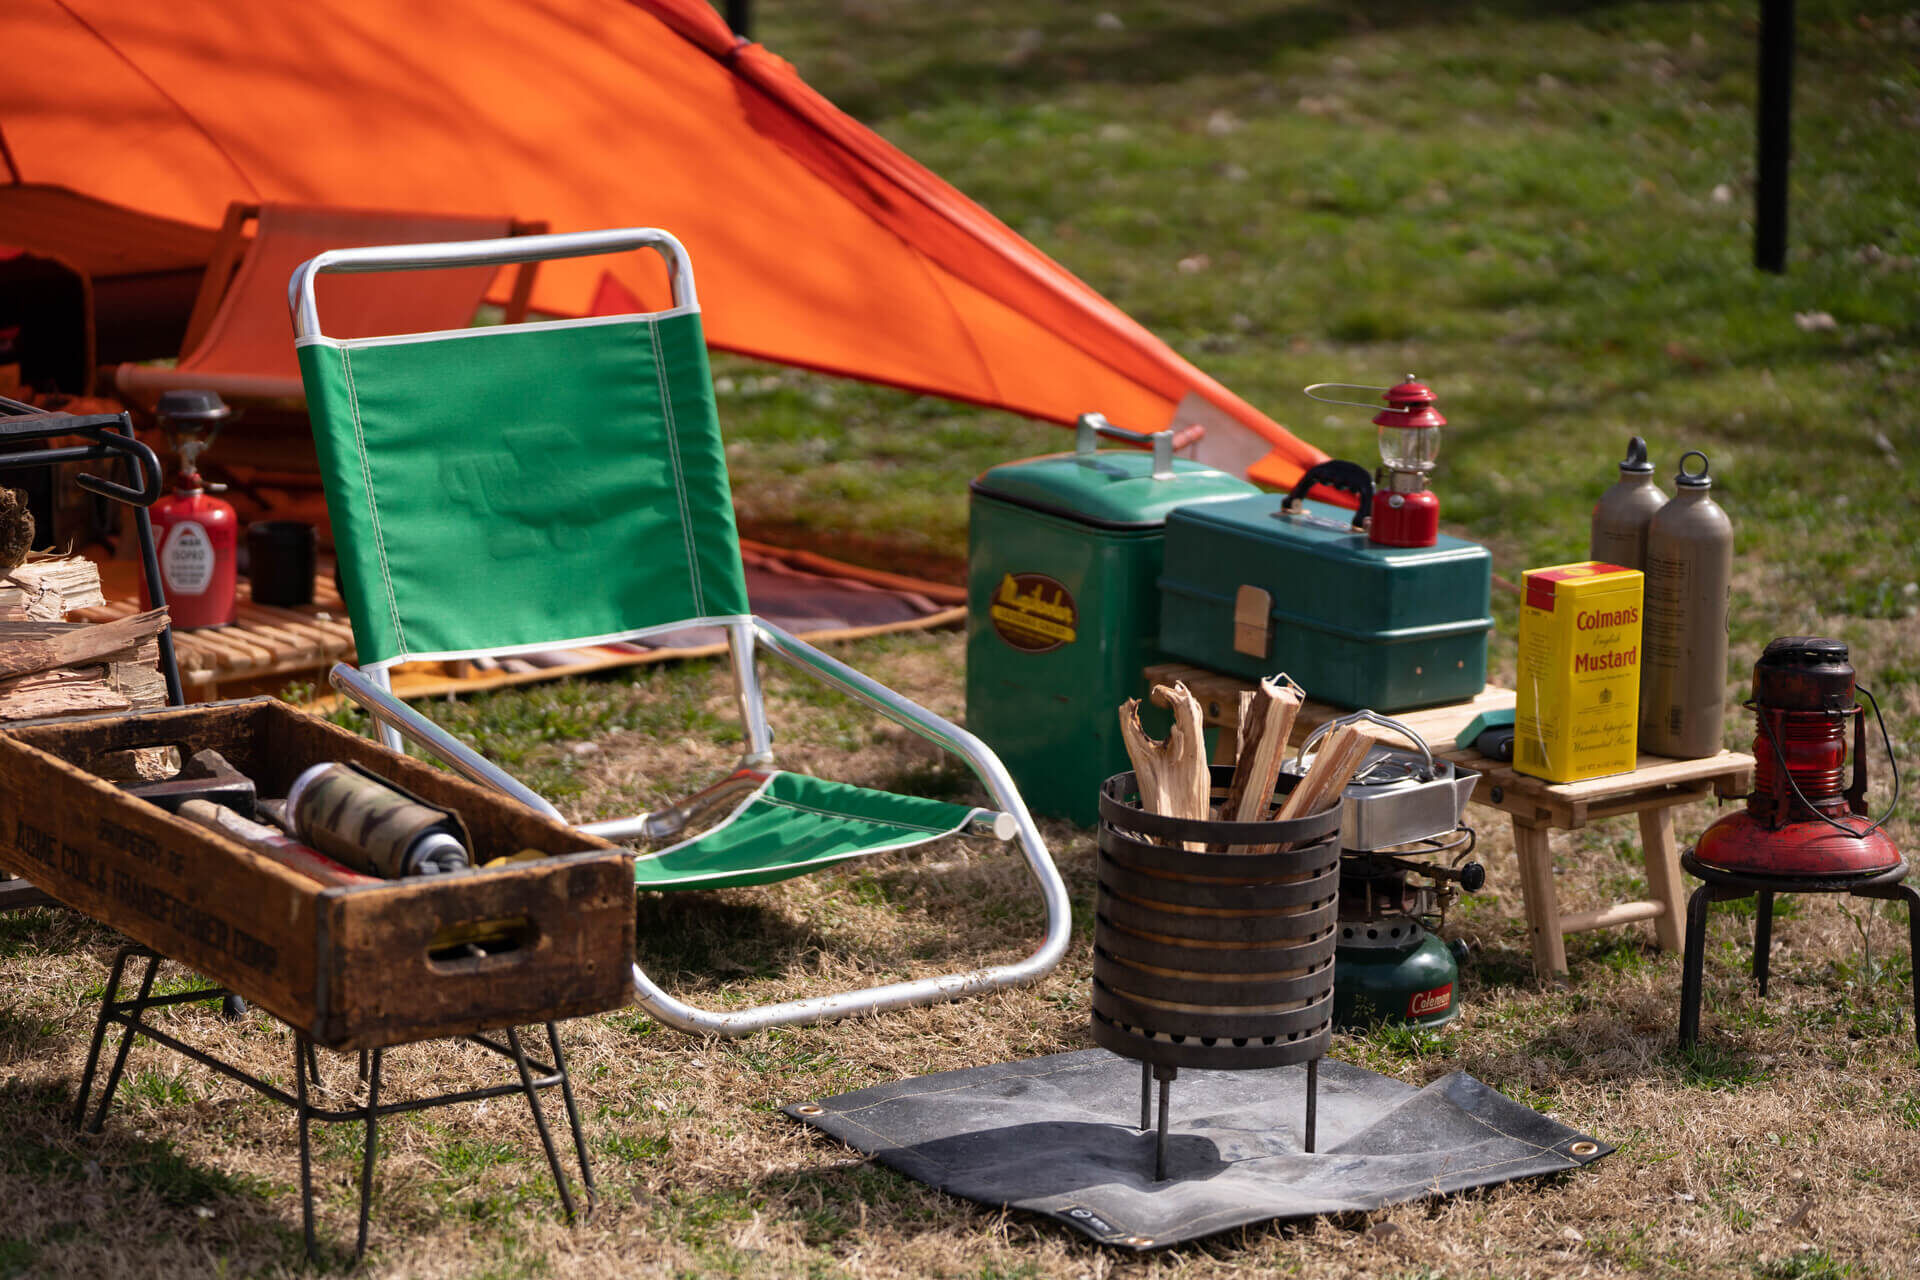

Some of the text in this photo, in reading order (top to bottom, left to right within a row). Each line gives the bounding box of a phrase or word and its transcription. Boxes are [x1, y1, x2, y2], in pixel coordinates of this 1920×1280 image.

[1576, 606, 1639, 631] Colman's
[1575, 645, 1637, 674] Mustard
[16, 820, 57, 869] ACME
[112, 870, 230, 955] TRANSFORMER
